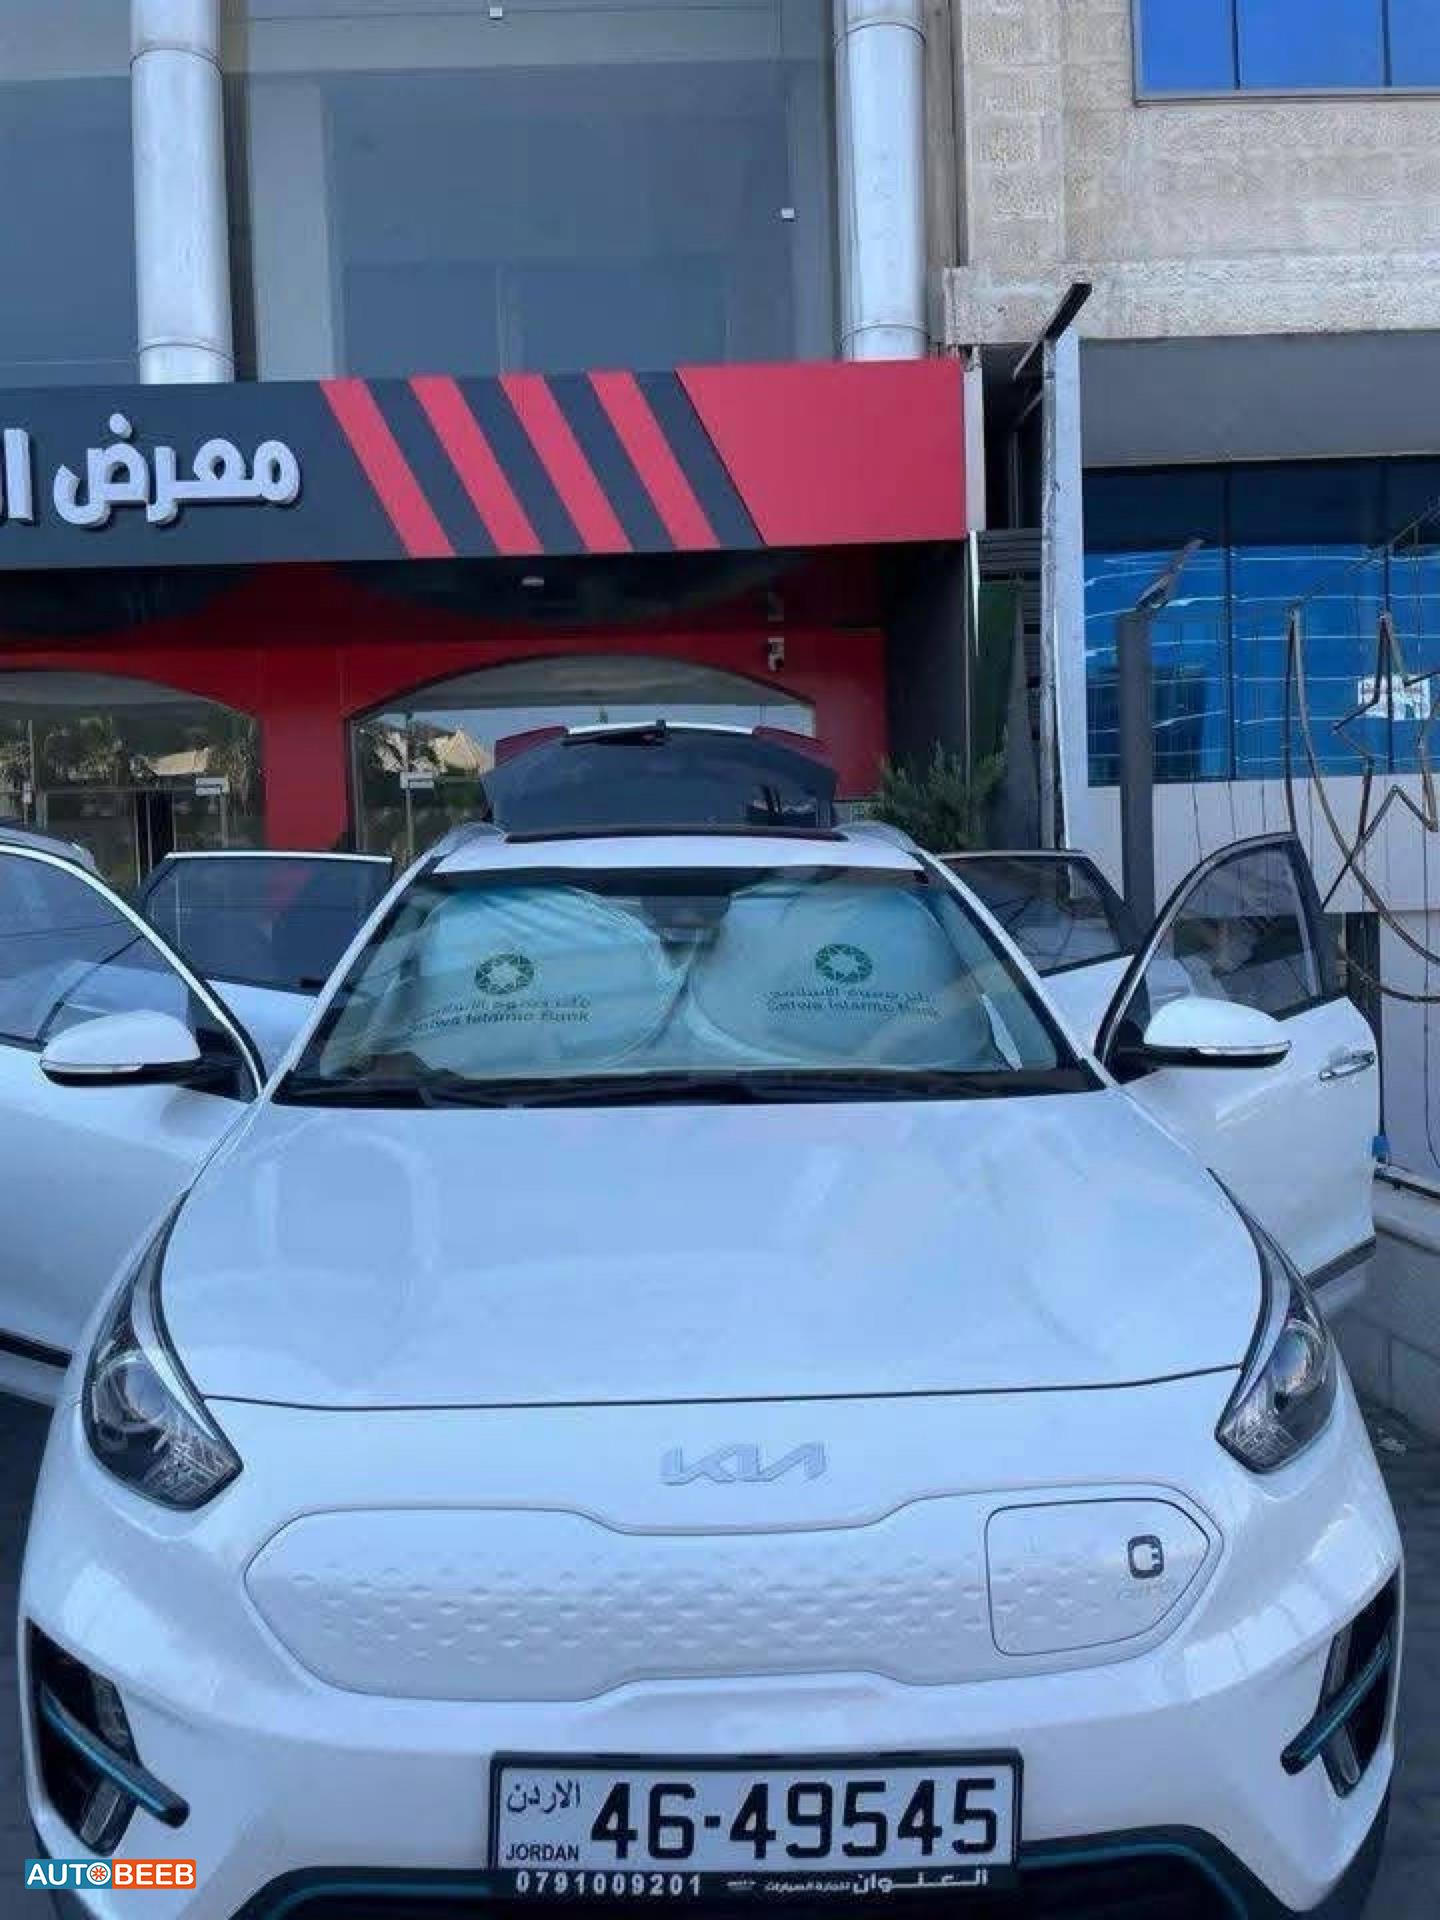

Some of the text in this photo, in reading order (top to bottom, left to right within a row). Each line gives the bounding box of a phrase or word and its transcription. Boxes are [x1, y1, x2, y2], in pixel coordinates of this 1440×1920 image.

[53, 413, 300, 526] معرض
[658, 1443, 827, 1487] KIA
[591, 1777, 998, 1861] 46-49545
[505, 1844, 580, 1862] JORDAN
[516, 1870, 701, 1896] 0791009201
